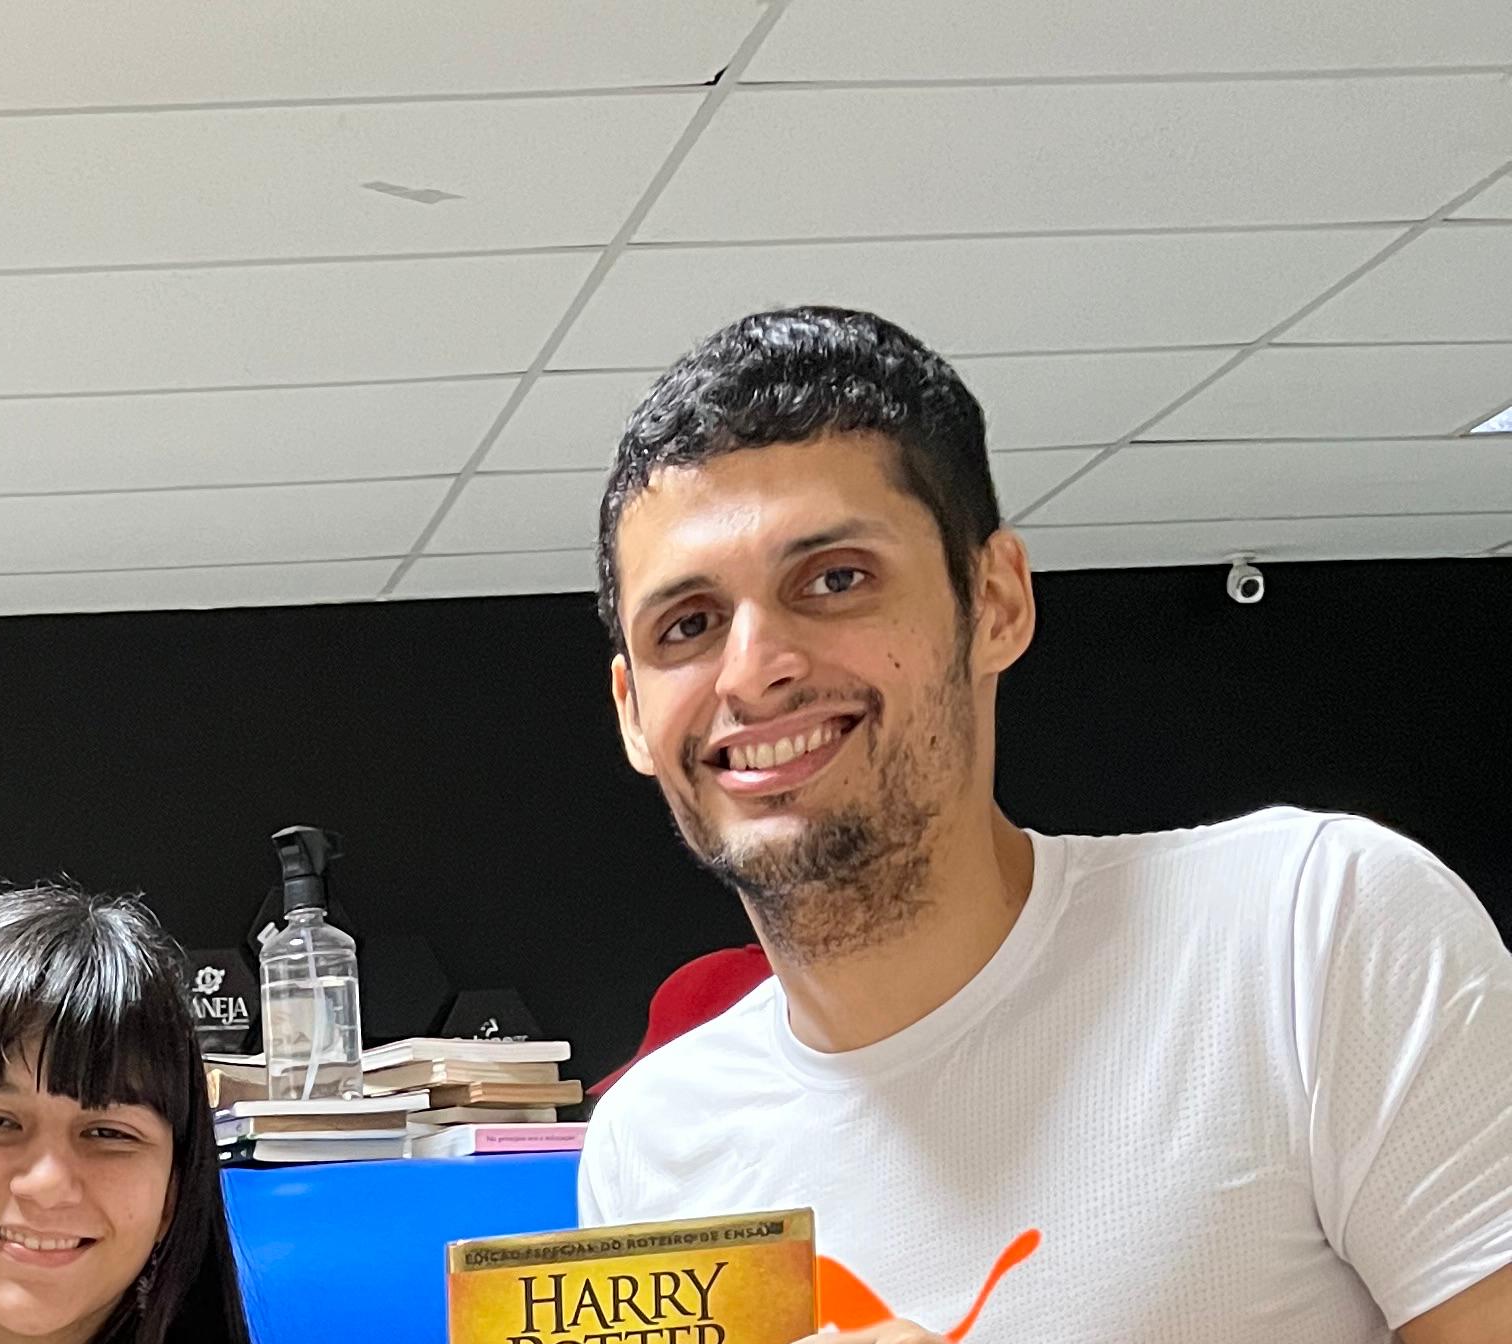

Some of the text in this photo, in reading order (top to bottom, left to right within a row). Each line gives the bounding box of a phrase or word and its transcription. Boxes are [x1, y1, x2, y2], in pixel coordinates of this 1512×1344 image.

[627, 1233, 695, 1249] ROTEIRO
[700, 1230, 720, 1242] DE
[518, 1261, 730, 1335] HARRY
